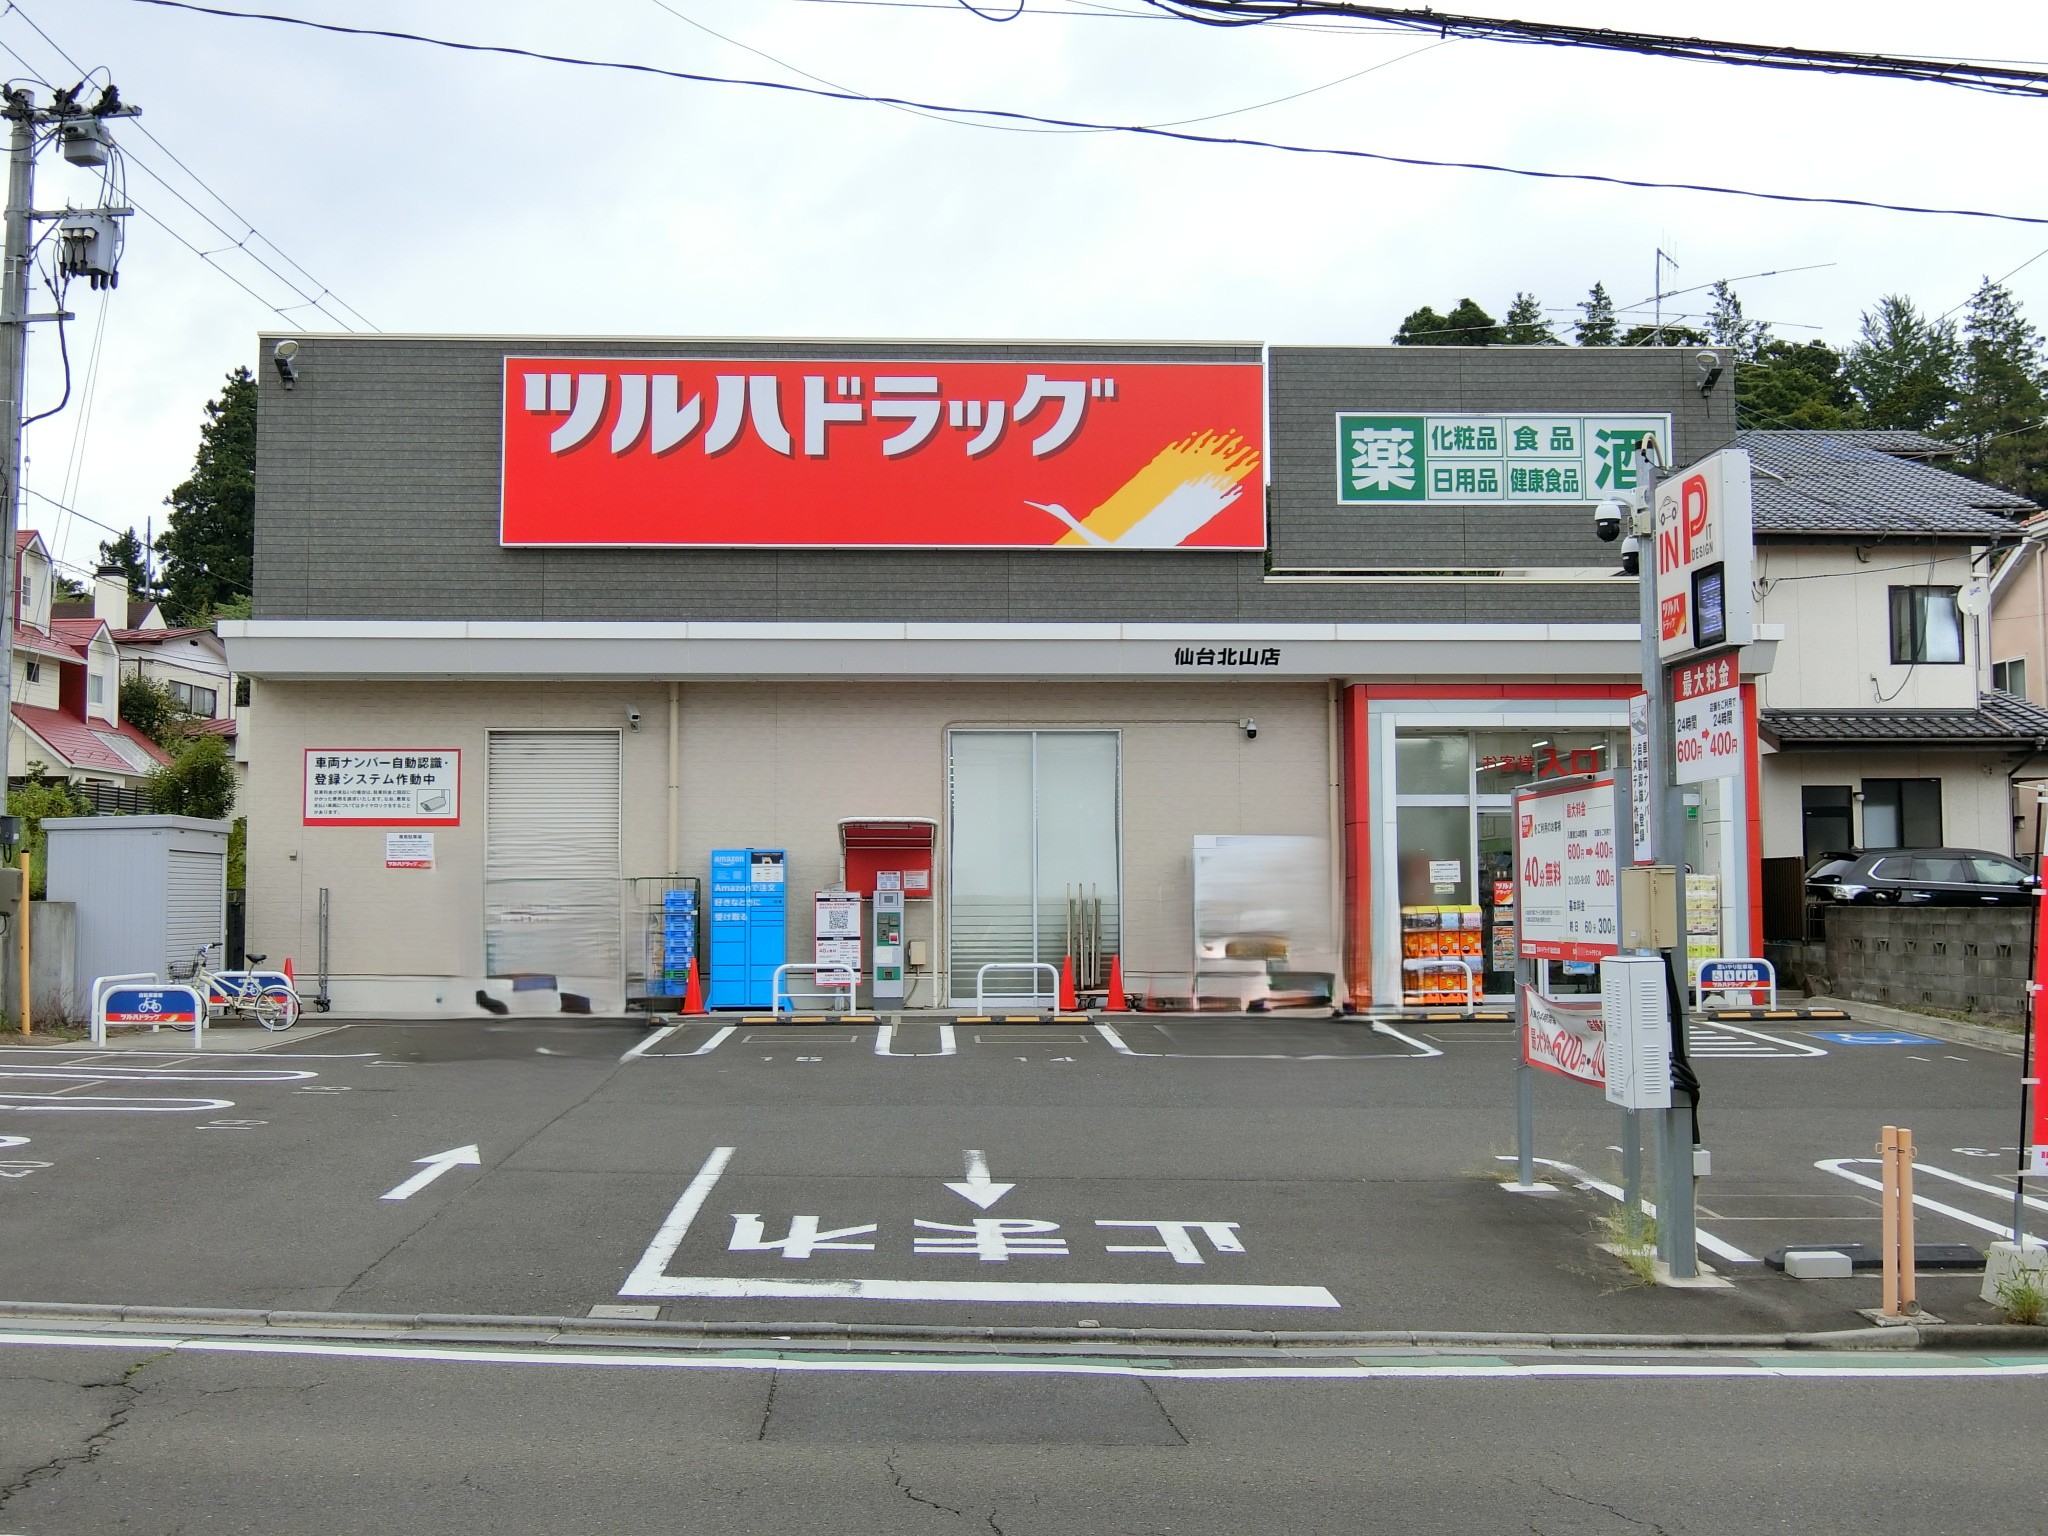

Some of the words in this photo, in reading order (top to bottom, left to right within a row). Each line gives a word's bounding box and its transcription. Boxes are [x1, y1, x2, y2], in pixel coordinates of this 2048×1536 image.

[523, 372, 1115, 457] ツルハドラッグ
[1432, 425, 1498, 451] 化粧品
[1513, 425, 1574, 451] 食品
[1351, 427, 1416, 491] 薬
[1595, 428, 1656, 490] 酒
[1433, 468, 1498, 493] 日用品
[1510, 468, 1579, 493] 健康食品
[1682, 474, 1708, 565] P
[1705, 523, 1713, 541] IT
[1659, 525, 1679, 575] IN
[1691, 541, 1714, 561] DESIGN
[1662, 598, 1680, 618] ツルハ
[1174, 647, 1281, 666] 仙台北山店
[1682, 659, 1730, 697] 最大料金
[1677, 714, 1698, 733] 24時間
[1713, 709, 1733, 727] 24時間
[1677, 738, 1703, 763] 600円
[1710, 731, 1738, 757] 400円
[315, 773, 436, 786] 登録システム作動中
[1567, 843, 1585, 860] 600円
[1594, 841, 1614, 859] 400円
[1524, 856, 1562, 888] 40分無料
[1596, 869, 1615, 887] 300円
[714, 884, 776, 892] Amazonで注文
[1598, 917, 1616, 935] 300円
[120, 1013, 161, 1021] ツルハドラッグ
[727, 1212, 1247, 1265] 止まれ
